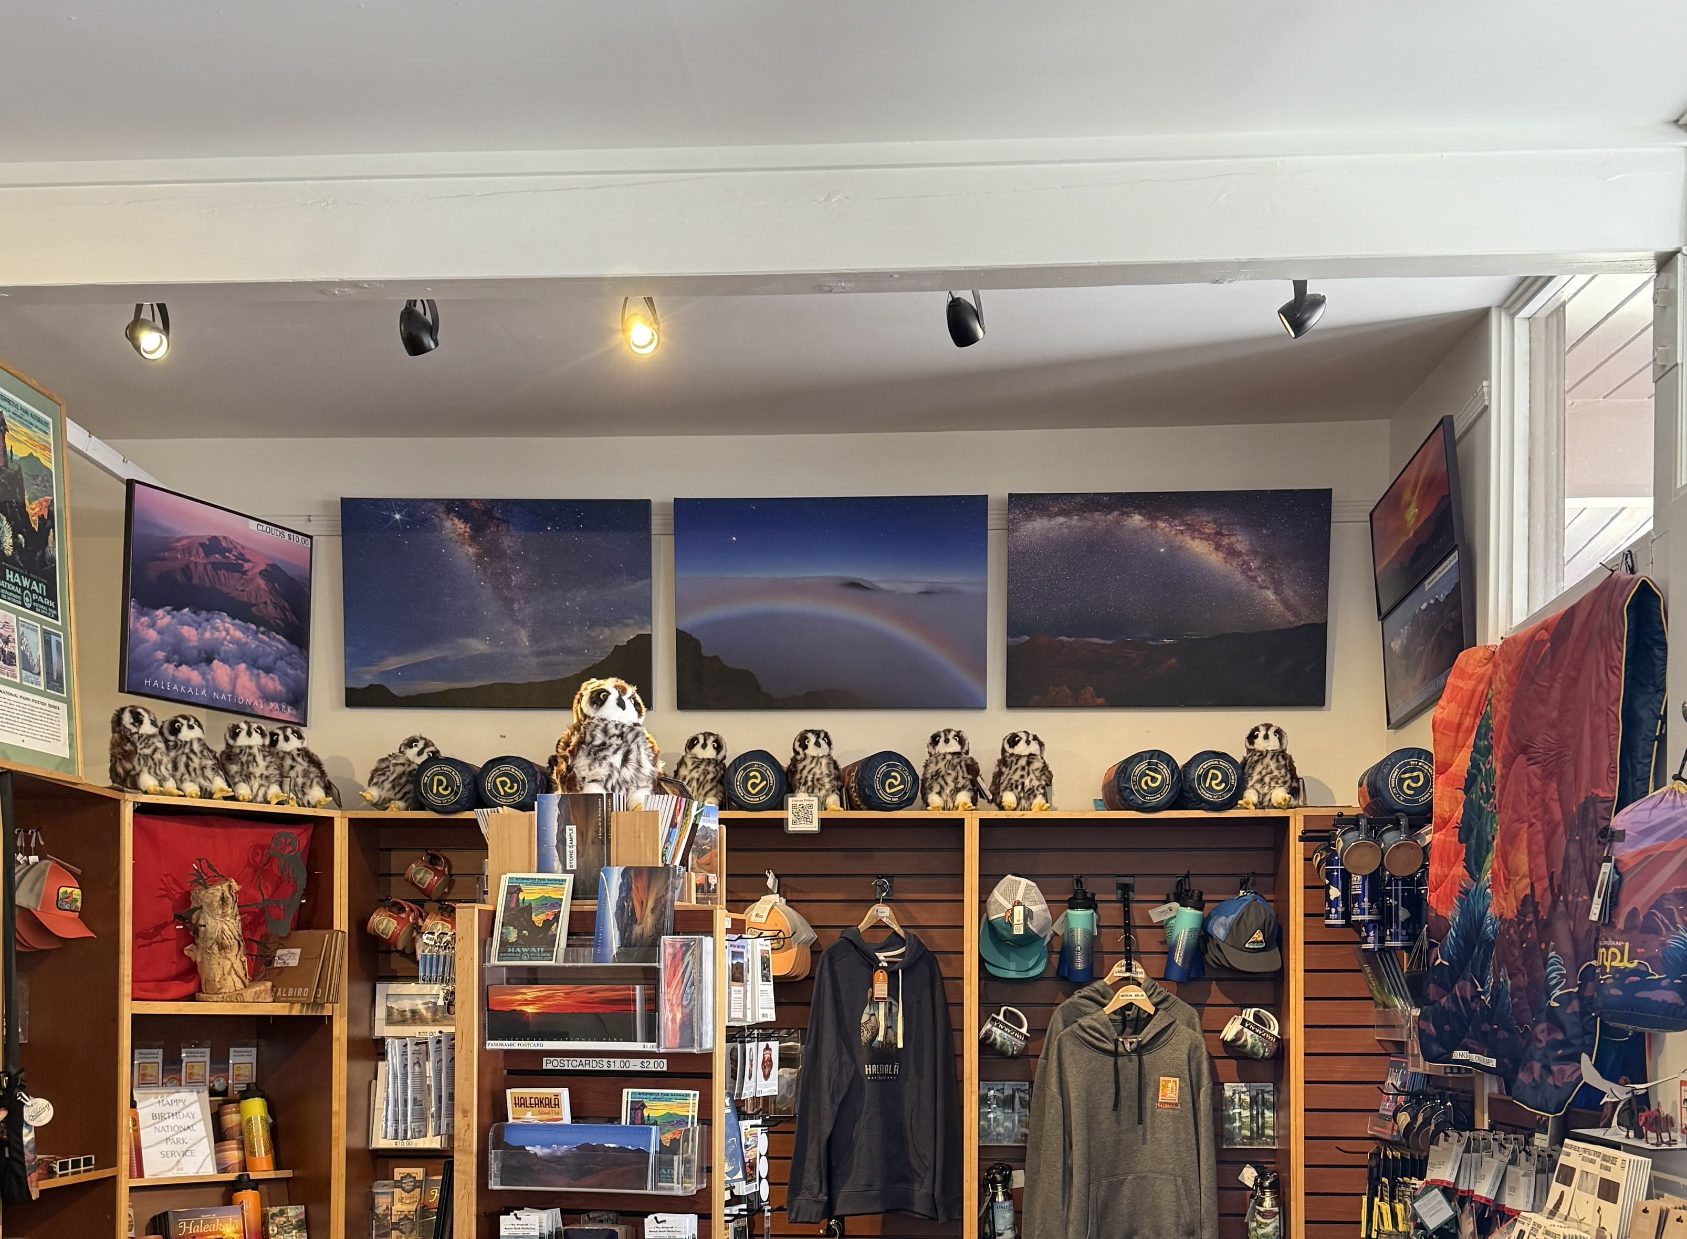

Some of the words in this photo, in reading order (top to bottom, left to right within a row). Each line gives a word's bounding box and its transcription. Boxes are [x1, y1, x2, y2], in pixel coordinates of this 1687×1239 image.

[256, 523, 286, 539] CLOUDS
[32, 594, 55, 608] PARK
[213, 691, 264, 709] NATIONAL
[269, 702, 293, 714] PARK
[545, 1058, 605, 1069] POSTCARDS
[606, 1059, 631, 1069] $1.00
[640, 1060, 665, 1070] $2.00
[158, 1099, 187, 1108] HAPPY
[513, 1094, 560, 1109] HALEAKALĀ
[151, 1111, 196, 1121] BIRTHDAY
[154, 1124, 197, 1133] NATIONAL
[165, 1137, 188, 1145] PARK
[160, 1149, 196, 1159] SERVICE
[178, 1217, 239, 1236] Haleakalā
